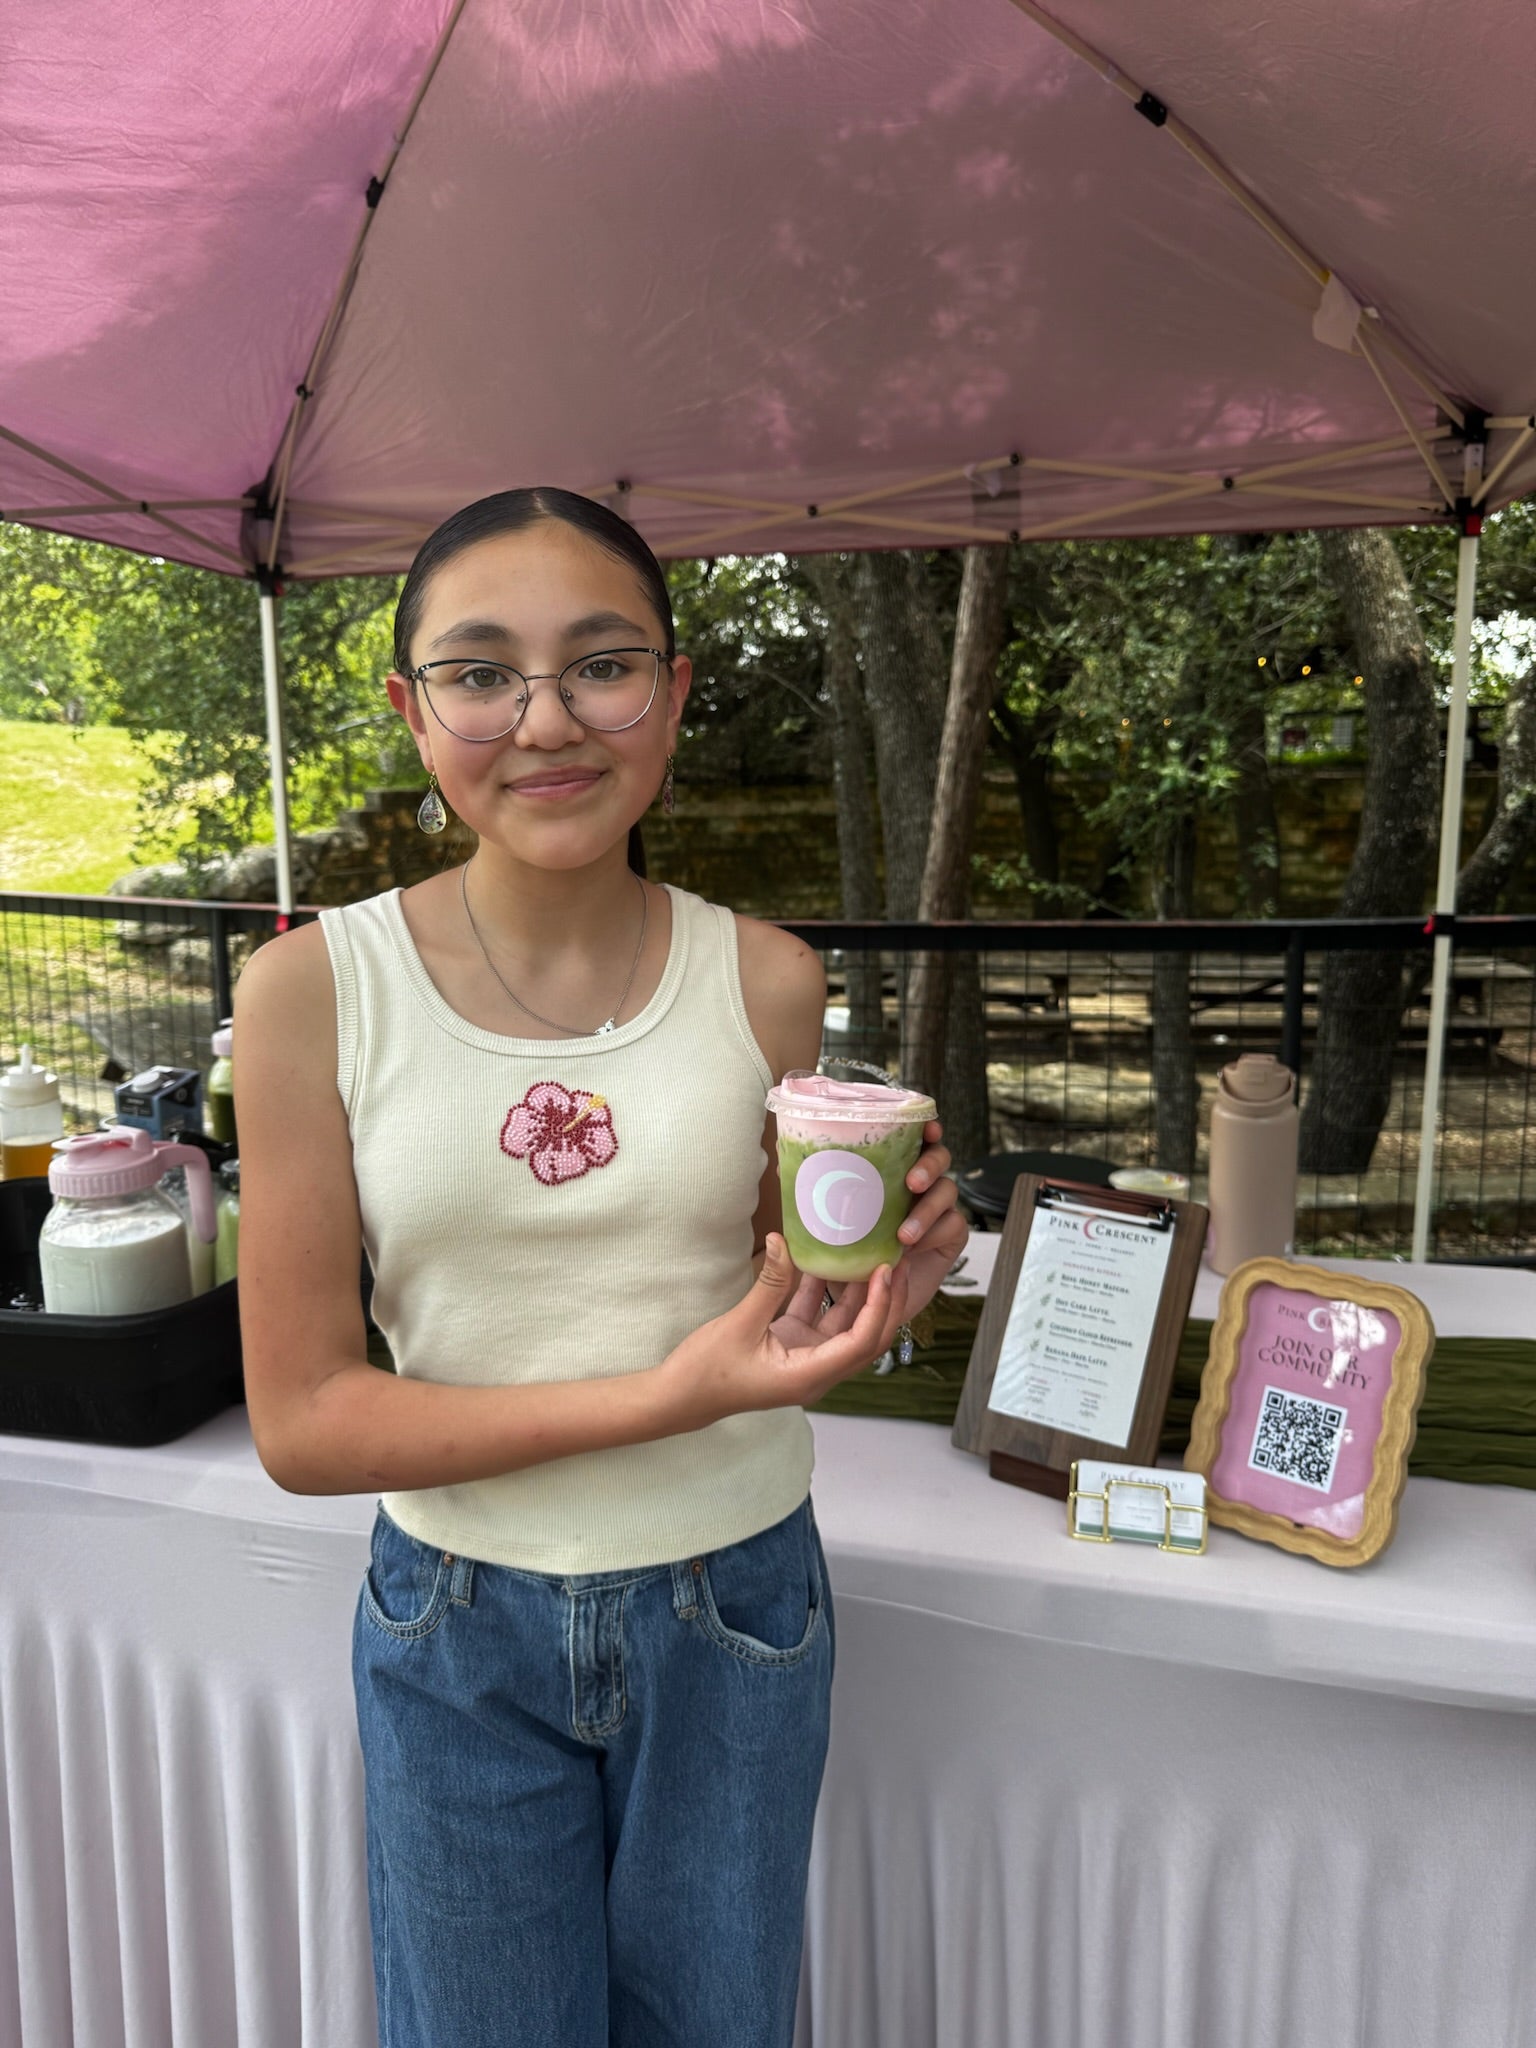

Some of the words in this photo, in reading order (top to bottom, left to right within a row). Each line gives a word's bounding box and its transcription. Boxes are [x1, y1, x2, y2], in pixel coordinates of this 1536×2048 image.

[1049, 1215, 1080, 1231] PINK
[1096, 1224, 1157, 1245] CRESCENT
[1278, 1305, 1305, 1320] PINK
[1272, 1335, 1315, 1357] JOIN
[1319, 1347, 1359, 1370] OR
